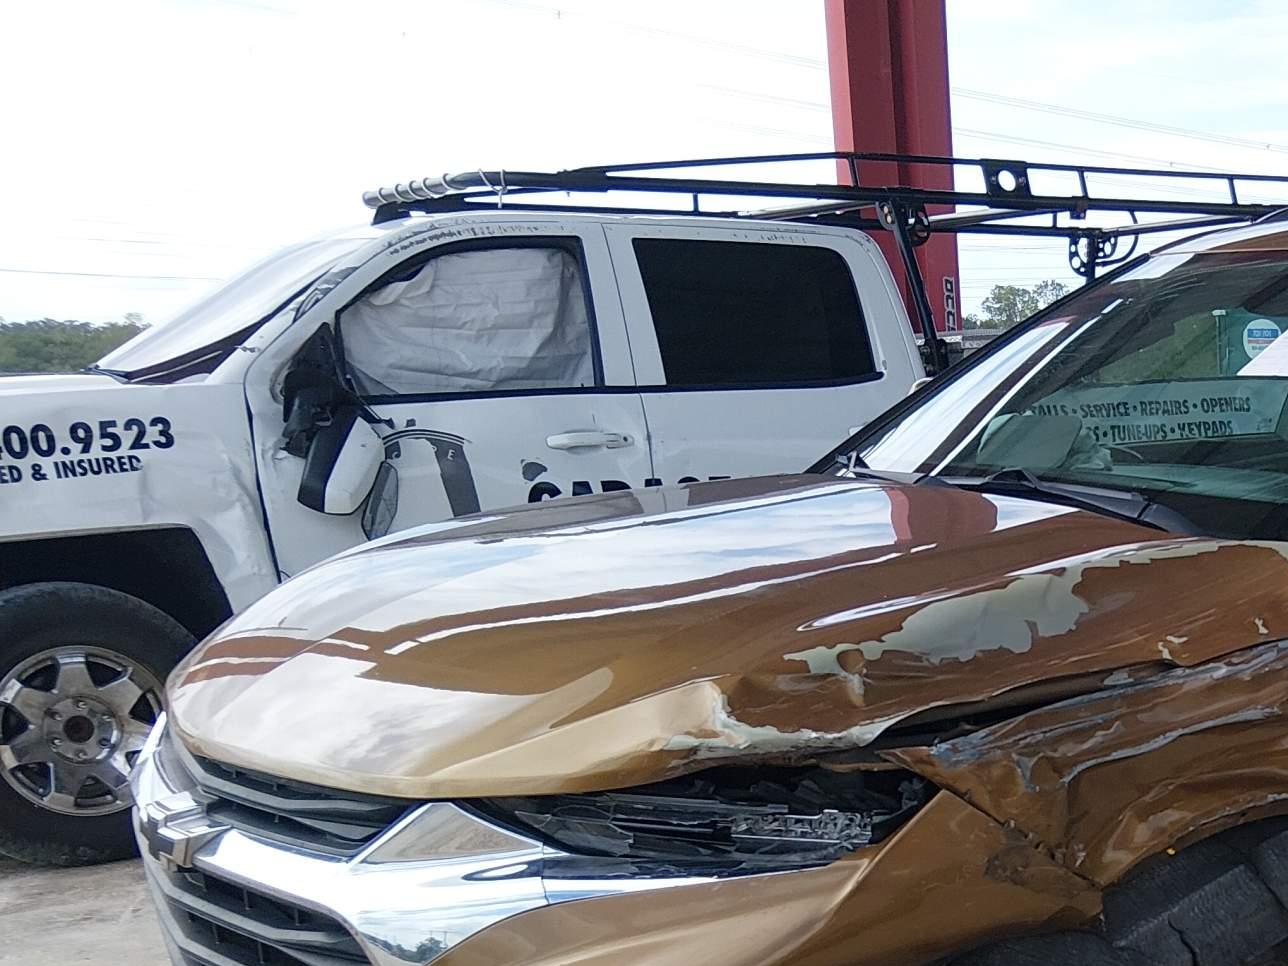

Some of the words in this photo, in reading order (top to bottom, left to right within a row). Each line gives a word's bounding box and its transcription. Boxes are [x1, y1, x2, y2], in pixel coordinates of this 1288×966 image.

[1081, 402, 1130, 418] SERVICE
[1139, 399, 1190, 417] REPAIRS
[1200, 397, 1251, 413] OPENERS
[0, 416, 175, 461] 00.9523
[1109, 422, 1168, 443] TUNE-UPS
[1178, 420, 1234, 439] KEYPADS
[31, 463, 50, 482] &
[53, 454, 144, 479] INSURED
